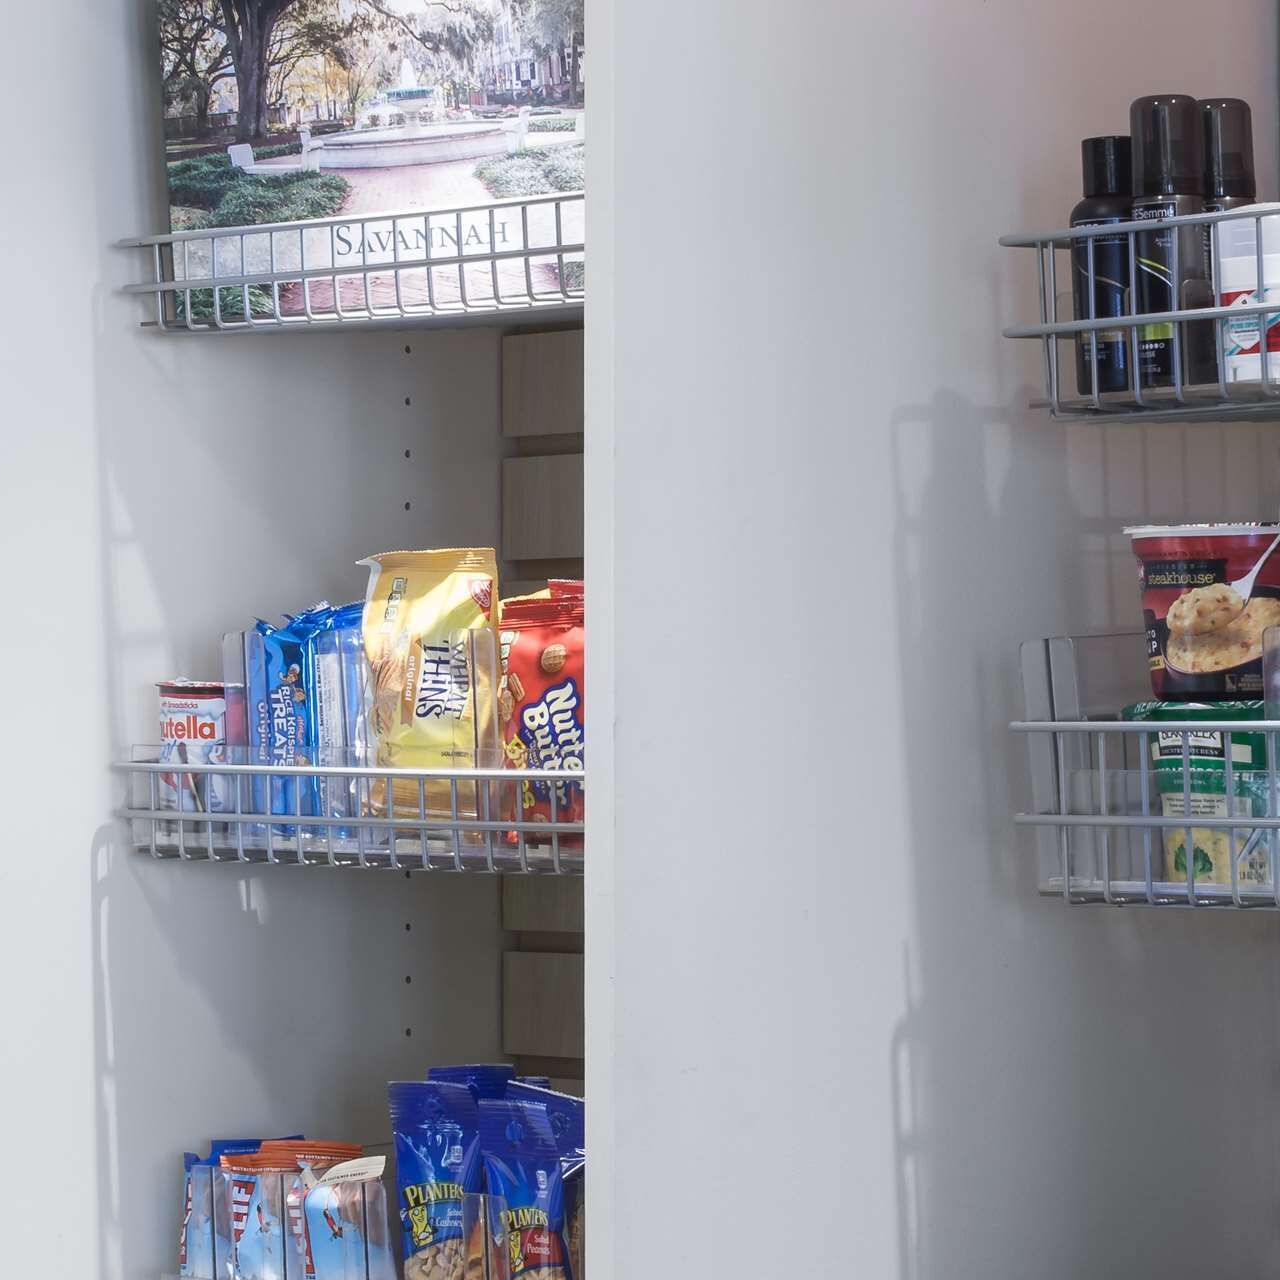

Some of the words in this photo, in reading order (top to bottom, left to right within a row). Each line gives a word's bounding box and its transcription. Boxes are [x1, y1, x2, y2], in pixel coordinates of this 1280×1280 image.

[336, 222, 511, 257] SAVANNAH
[1148, 569, 1216, 586] steakhouse
[405, 655, 415, 702] original
[416, 640, 449, 719] THINS
[443, 641, 469, 720] WHEAT
[281, 686, 294, 714] RICE
[287, 716, 297, 766] KRISPIE
[405, 1183, 464, 1208] PLANTERS
[500, 1207, 548, 1231] PLANTERS
